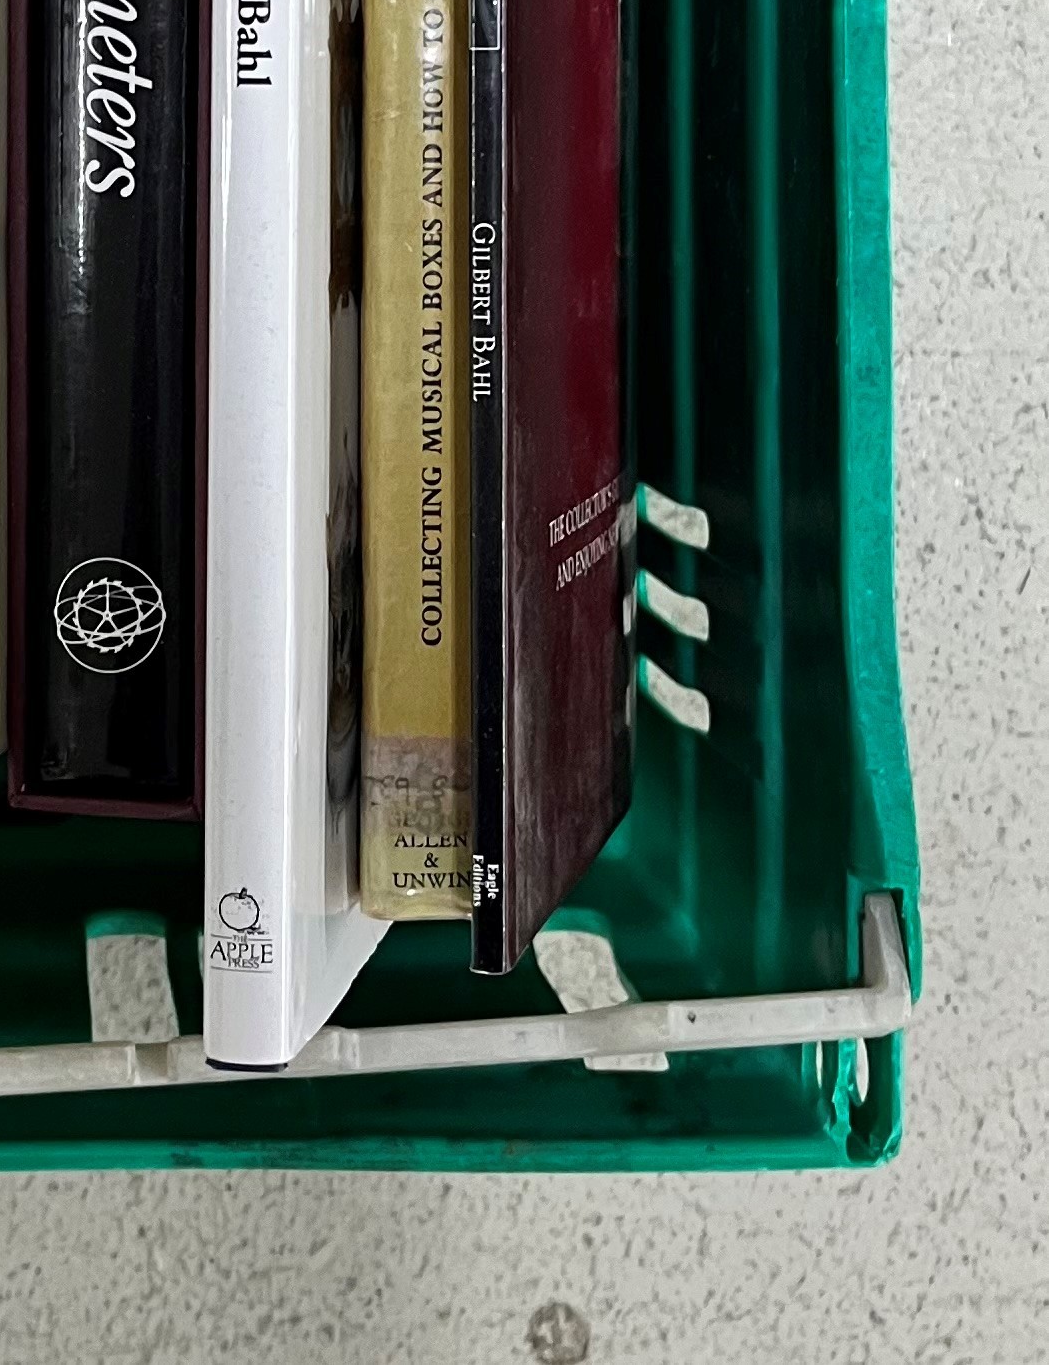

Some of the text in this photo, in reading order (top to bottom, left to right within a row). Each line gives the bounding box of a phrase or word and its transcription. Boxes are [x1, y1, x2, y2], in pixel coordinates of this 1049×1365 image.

[423, 8, 445, 50] TO
[422, 61, 444, 133] HOW
[421, 142, 444, 208] AND
[421, 217, 443, 312] BOXES
[472, 221, 497, 403] GILBERT BAHL
[421, 321, 443, 455] MUSICAL
[421, 465, 443, 648] COLLECTING
[423, 851, 439, 869] &
[472, 854, 485, 907] Editions
[485, 863, 500, 900] Eagle
[210, 940, 273, 965] APPLE
